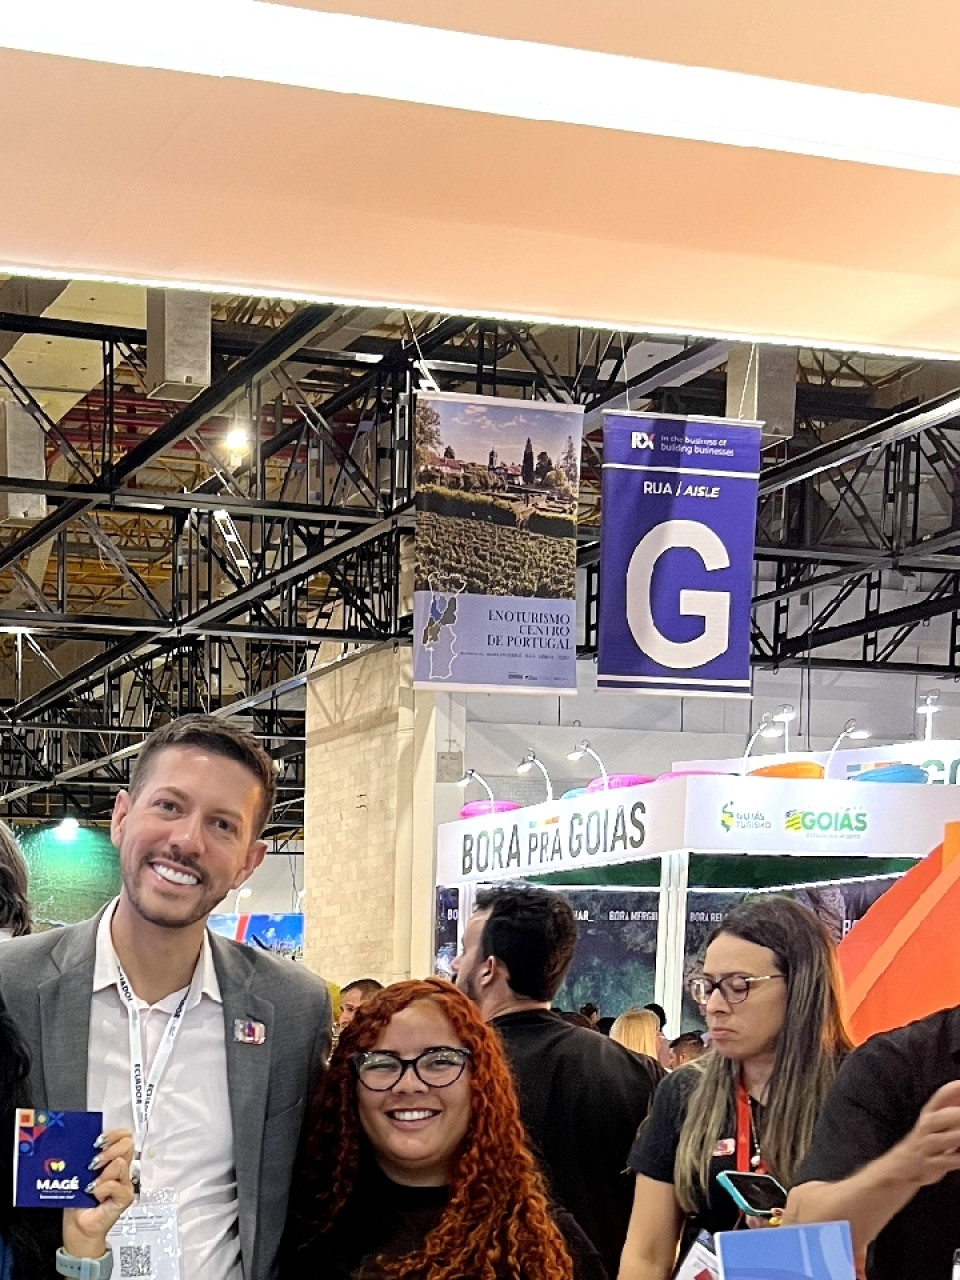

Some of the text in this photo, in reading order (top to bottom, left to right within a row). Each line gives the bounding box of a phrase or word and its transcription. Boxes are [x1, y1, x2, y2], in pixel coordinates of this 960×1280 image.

[660, 443, 734, 457] building businesses
[718, 439, 728, 447] of
[643, 480, 673, 495] RUA
[683, 484, 721, 498] AISLE
[626, 519, 731, 669] G
[488, 609, 570, 625] ENOTURISMO
[519, 625, 570, 637] CENTRO
[487, 634, 574, 650] DE PORTUGAL
[800, 807, 868, 832] GOIÁS
[462, 824, 521, 876] BORA
[690, 911, 709, 922] BORA
[36, 1175, 80, 1190] MAGÉ
